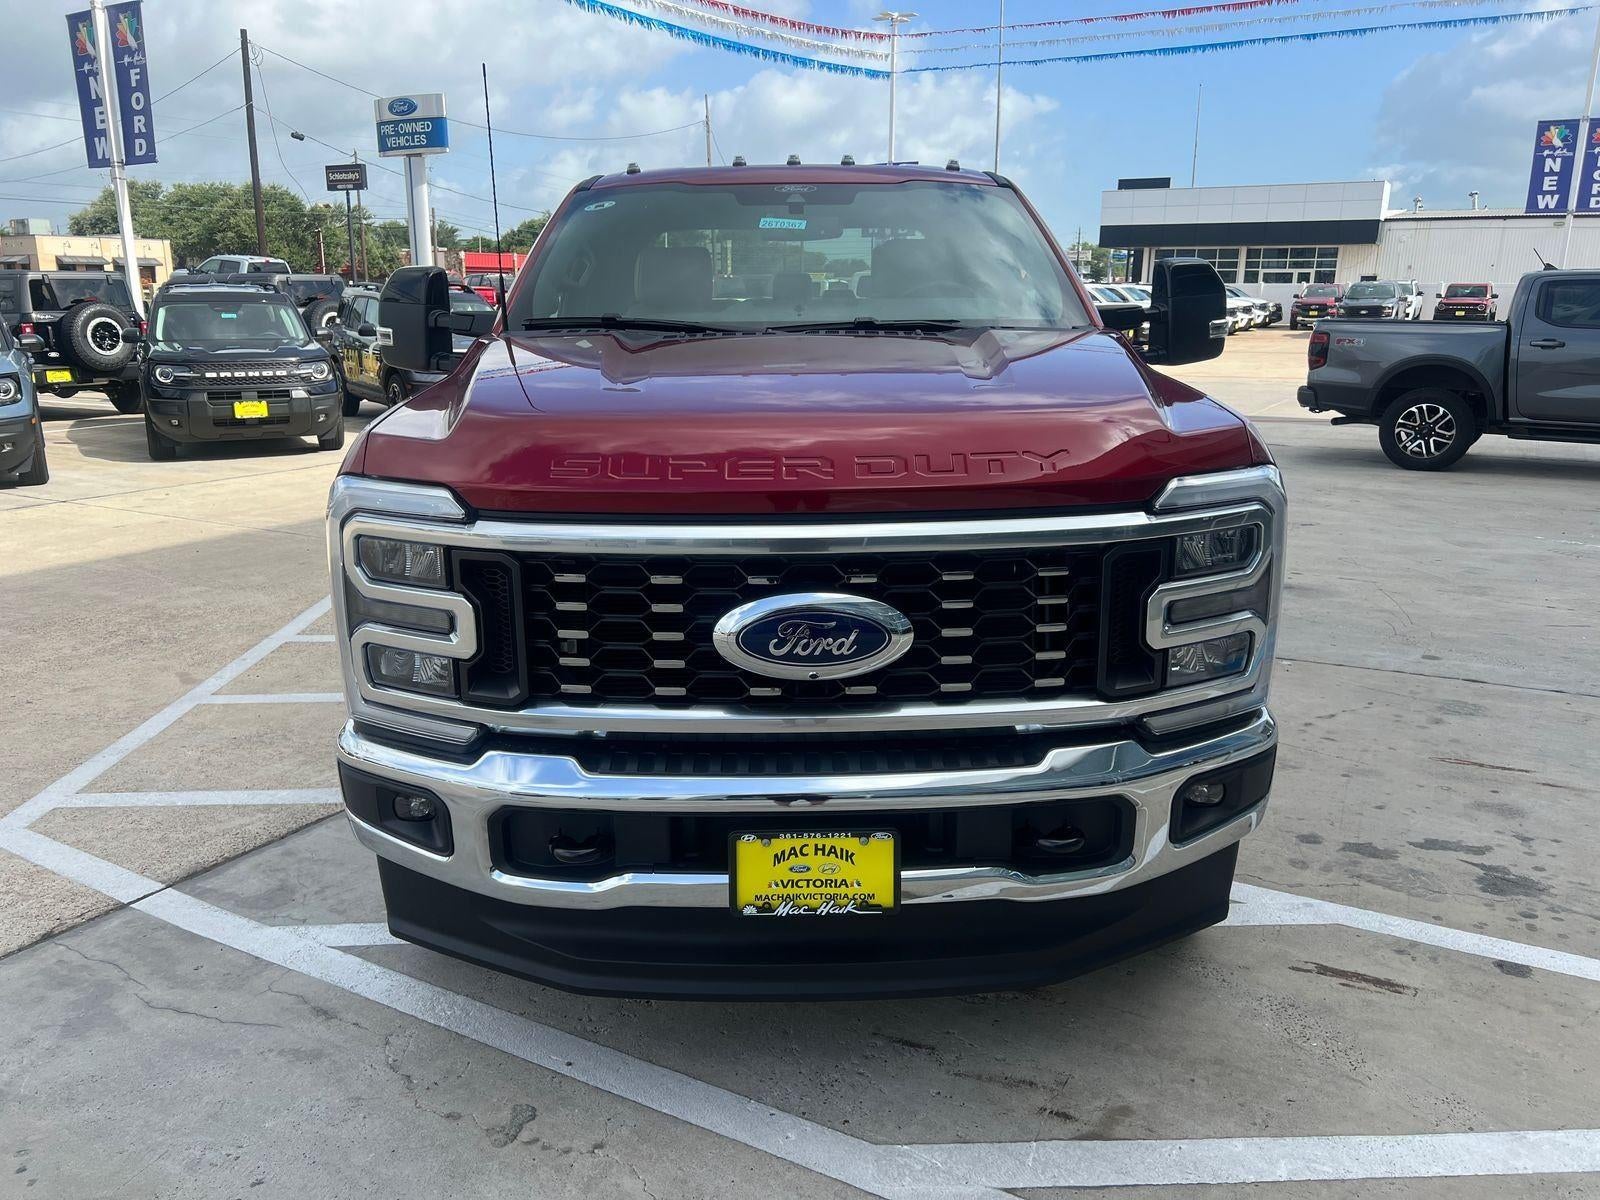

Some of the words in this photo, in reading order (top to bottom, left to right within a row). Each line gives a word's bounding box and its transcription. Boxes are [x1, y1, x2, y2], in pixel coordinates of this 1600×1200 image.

[129, 68, 147, 157] FORD
[392, 101, 409, 113] Ford
[381, 121, 432, 136] PRE-OWNED
[386, 134, 427, 148] VEHICLES
[780, 184, 809, 192] Ford
[1537, 157, 1562, 209] NEW
[205, 370, 288, 378] BRONCO
[549, 456, 835, 482] SUPER
[854, 448, 1070, 480] DUTY
[768, 619, 860, 656] Ford
[772, 843, 810, 867] MAC
[814, 843, 856, 866] HAIK
[778, 878, 850, 889] VICTORIA
[774, 900, 812, 917] Mac
[816, 900, 860, 916] Haik
